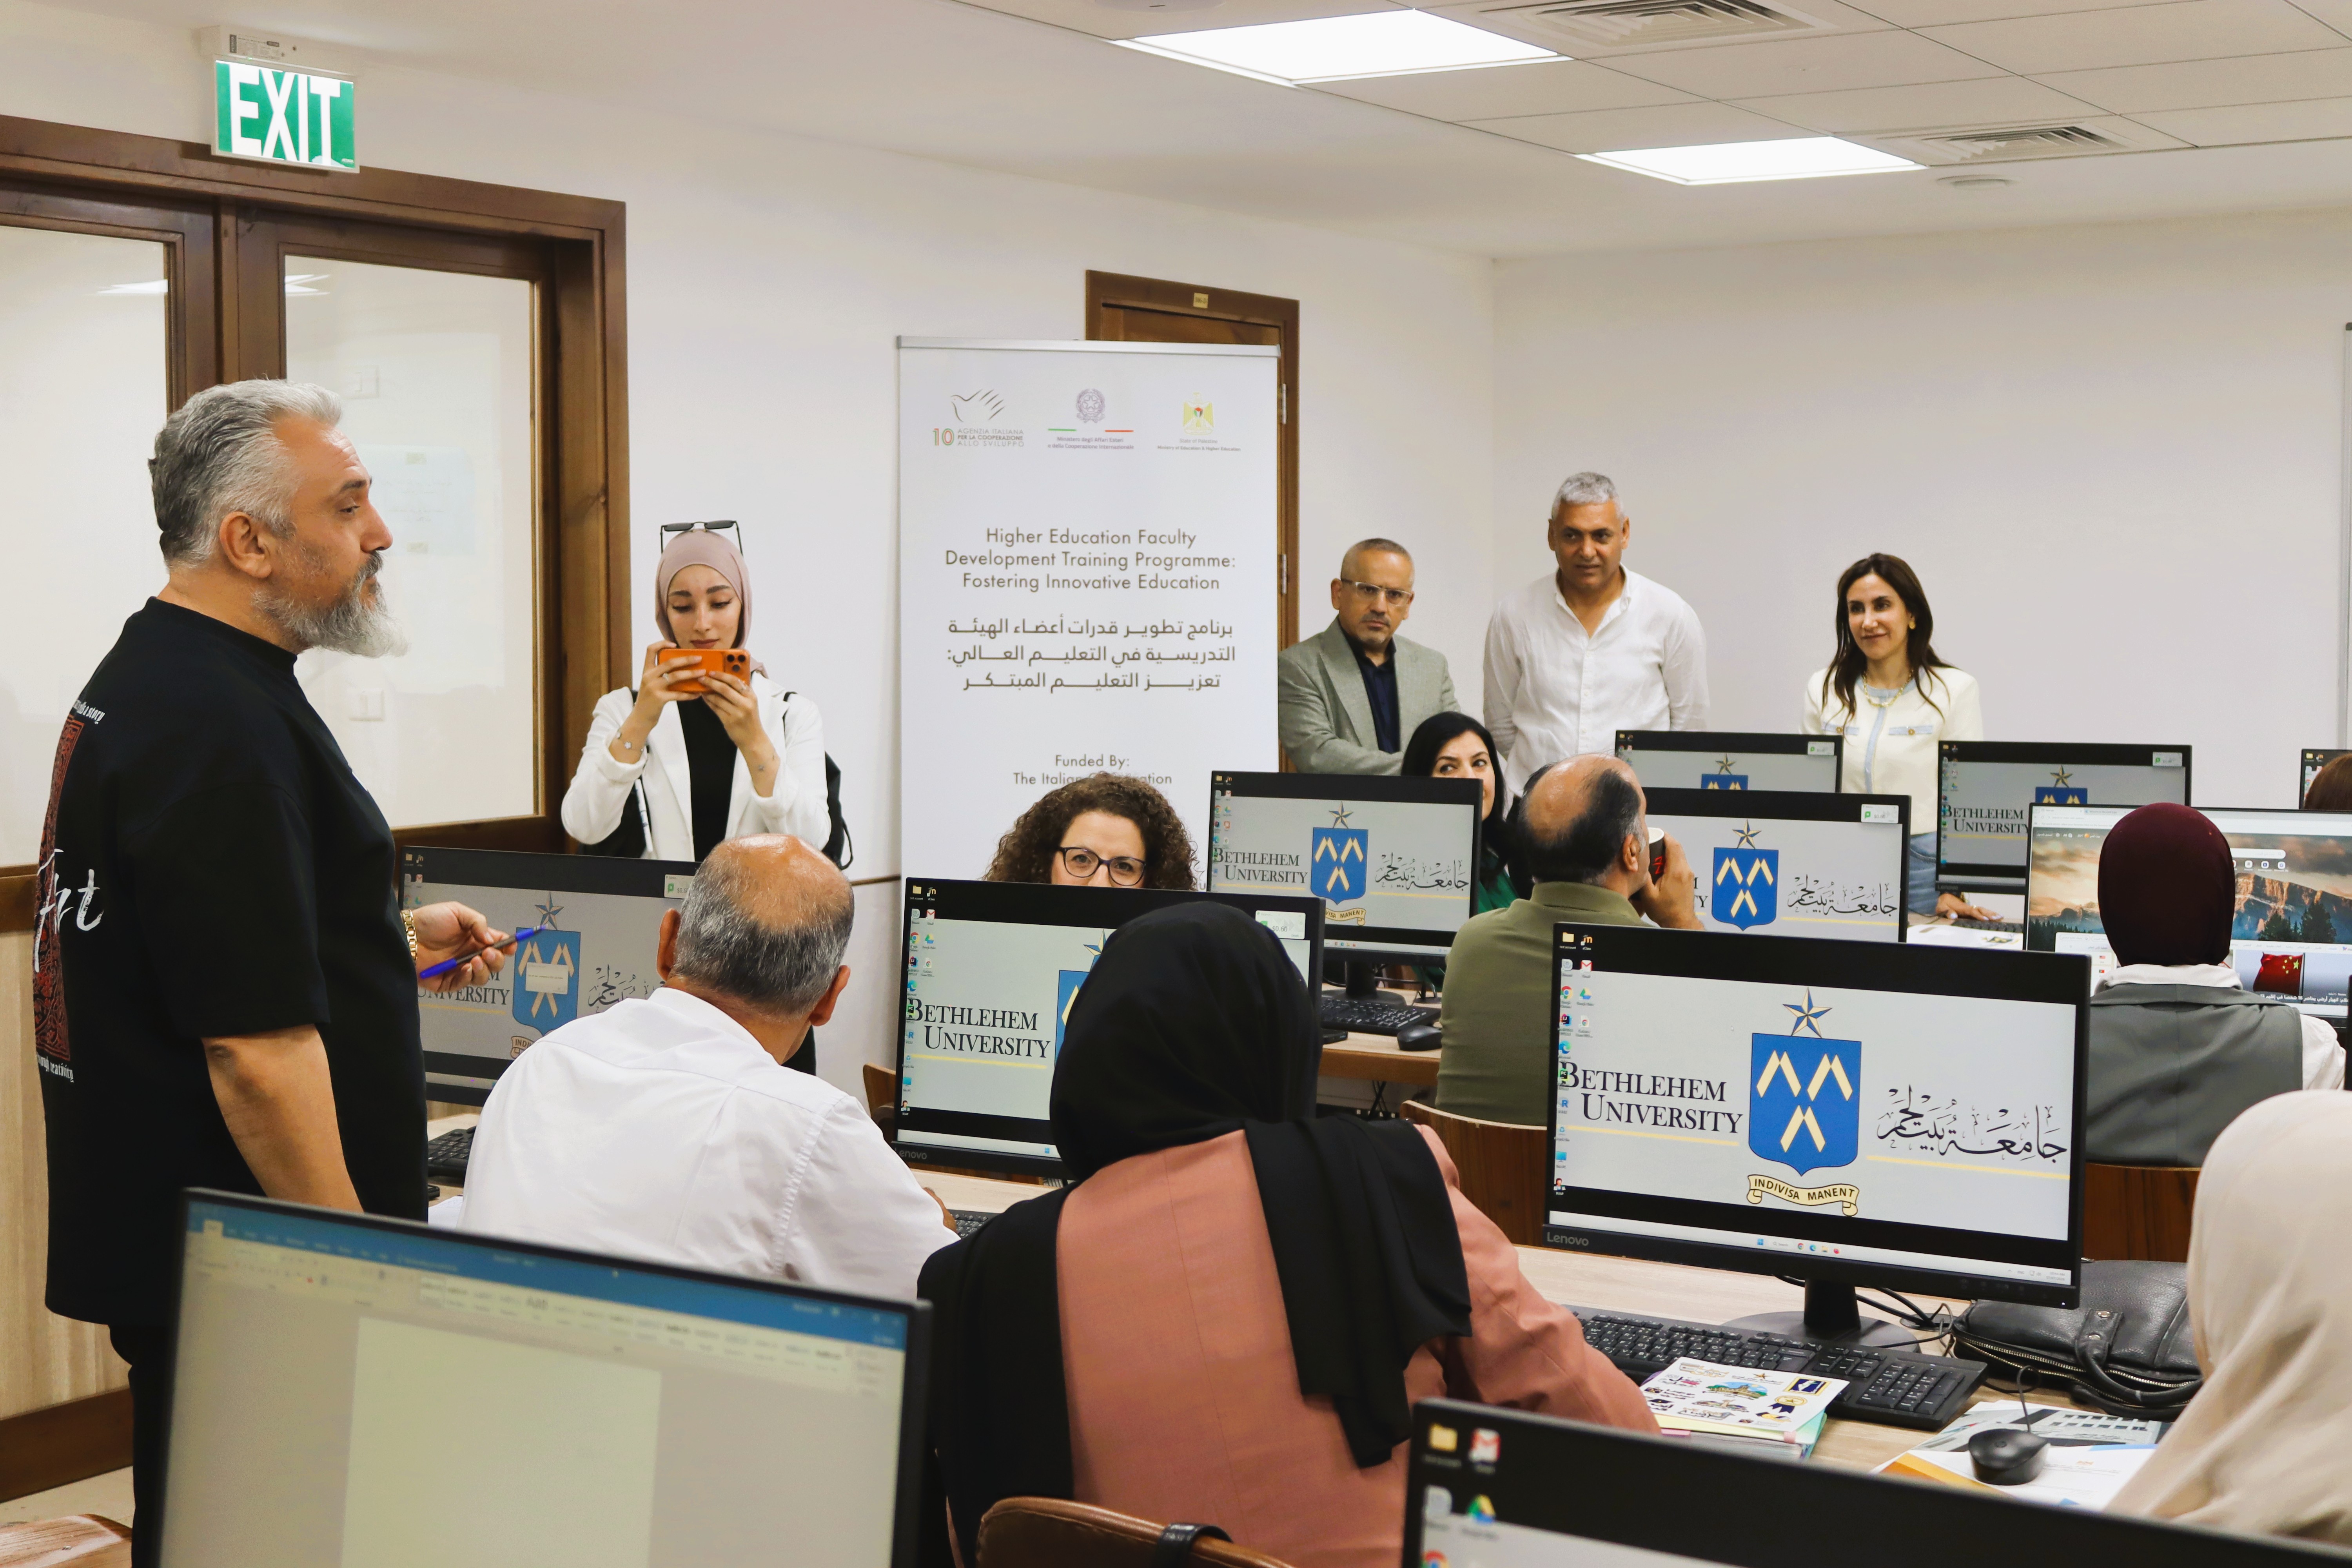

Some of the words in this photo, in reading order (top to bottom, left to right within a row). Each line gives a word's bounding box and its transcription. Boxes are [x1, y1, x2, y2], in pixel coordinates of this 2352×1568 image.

[229, 63, 340, 166] EXIT
[933, 428, 955, 446] 10
[987, 527, 1042, 548] Higher
[1050, 528, 1131, 544] Education
[1138, 528, 1196, 549] Faculty
[946, 550, 1056, 570] Development
[1062, 551, 1128, 571] Training
[1136, 552, 1235, 571] Programme:
[964, 573, 1039, 592] Fostering
[1047, 574, 1131, 589] Innovative
[1138, 573, 1219, 590] Education
[1014, 614, 1063, 634] أعضاء
[1068, 619, 1118, 638] قدرات
[1123, 619, 1182, 638] تطوير
[1187, 619, 1232, 641] برنامج
[1029, 646, 1106, 667] التعليم
[1111, 648, 1141, 668] في
[1051, 673, 1138, 694] التعليم
[1056, 754, 1103, 767] Funded
[1110, 754, 1129, 770] By:
[1013, 772, 1036, 784] The
[1941, 804, 2024, 820] BETHLEHEM
[1953, 819, 2029, 833] UNIVERSITY
[1213, 848, 1300, 866] BETHLEHEM
[1225, 864, 1308, 883] UNIVERSITY
[1340, 910, 1364, 918] MANENT
[906, 998, 1038, 1030] BETHLEHEM
[924, 1025, 1051, 1058] UNIVERSITY
[1558, 1061, 1727, 1102] BETHLEHEM
[1581, 1093, 1743, 1133] UNIVERSITY
[1755, 1179, 1800, 1200] INDIVISA
[1808, 1188, 1855, 1201] MANENT
[1547, 1232, 1589, 1246] Lenovo
